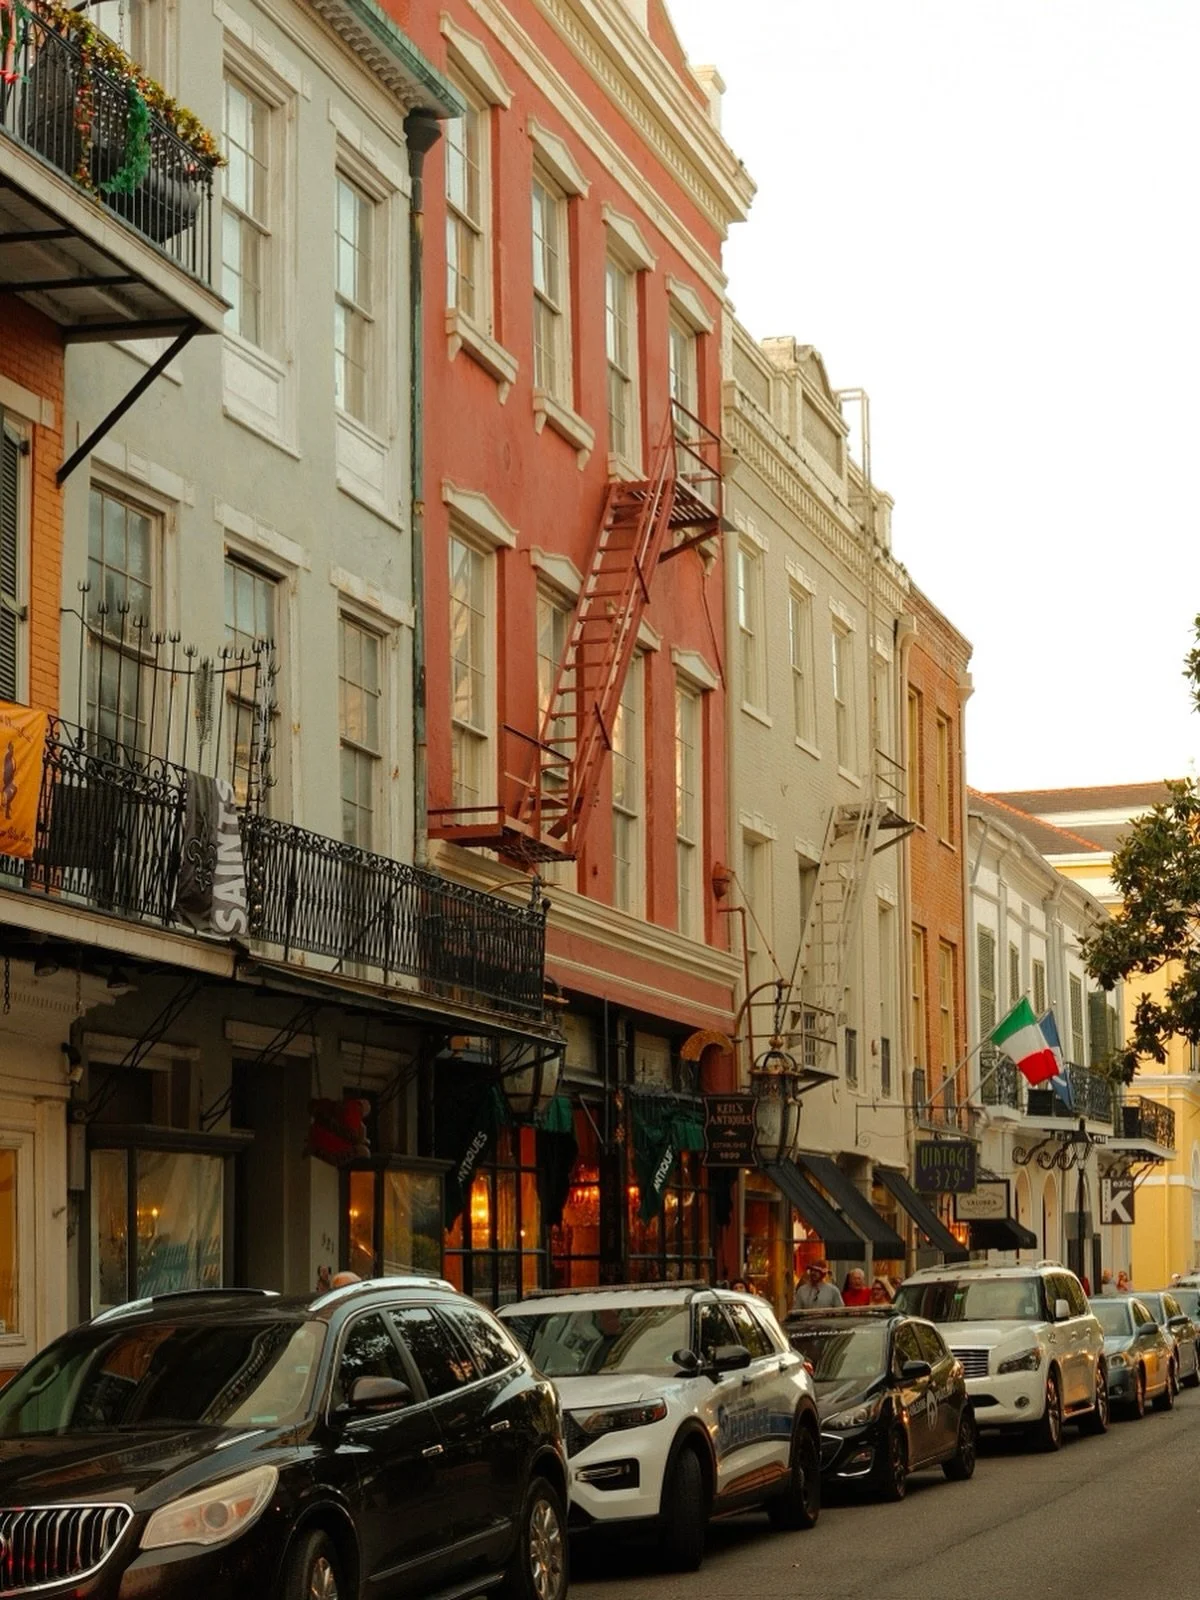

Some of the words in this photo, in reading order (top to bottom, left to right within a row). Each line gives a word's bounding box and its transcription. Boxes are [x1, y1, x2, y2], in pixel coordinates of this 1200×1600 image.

[212, 779, 247, 934] SAINTS
[709, 1115, 752, 1126] ANTIQUES
[716, 1103, 744, 1114] KEIL'S
[457, 1130, 488, 1185] ANTIQUES
[920, 1146, 971, 1171] VINTAGE
